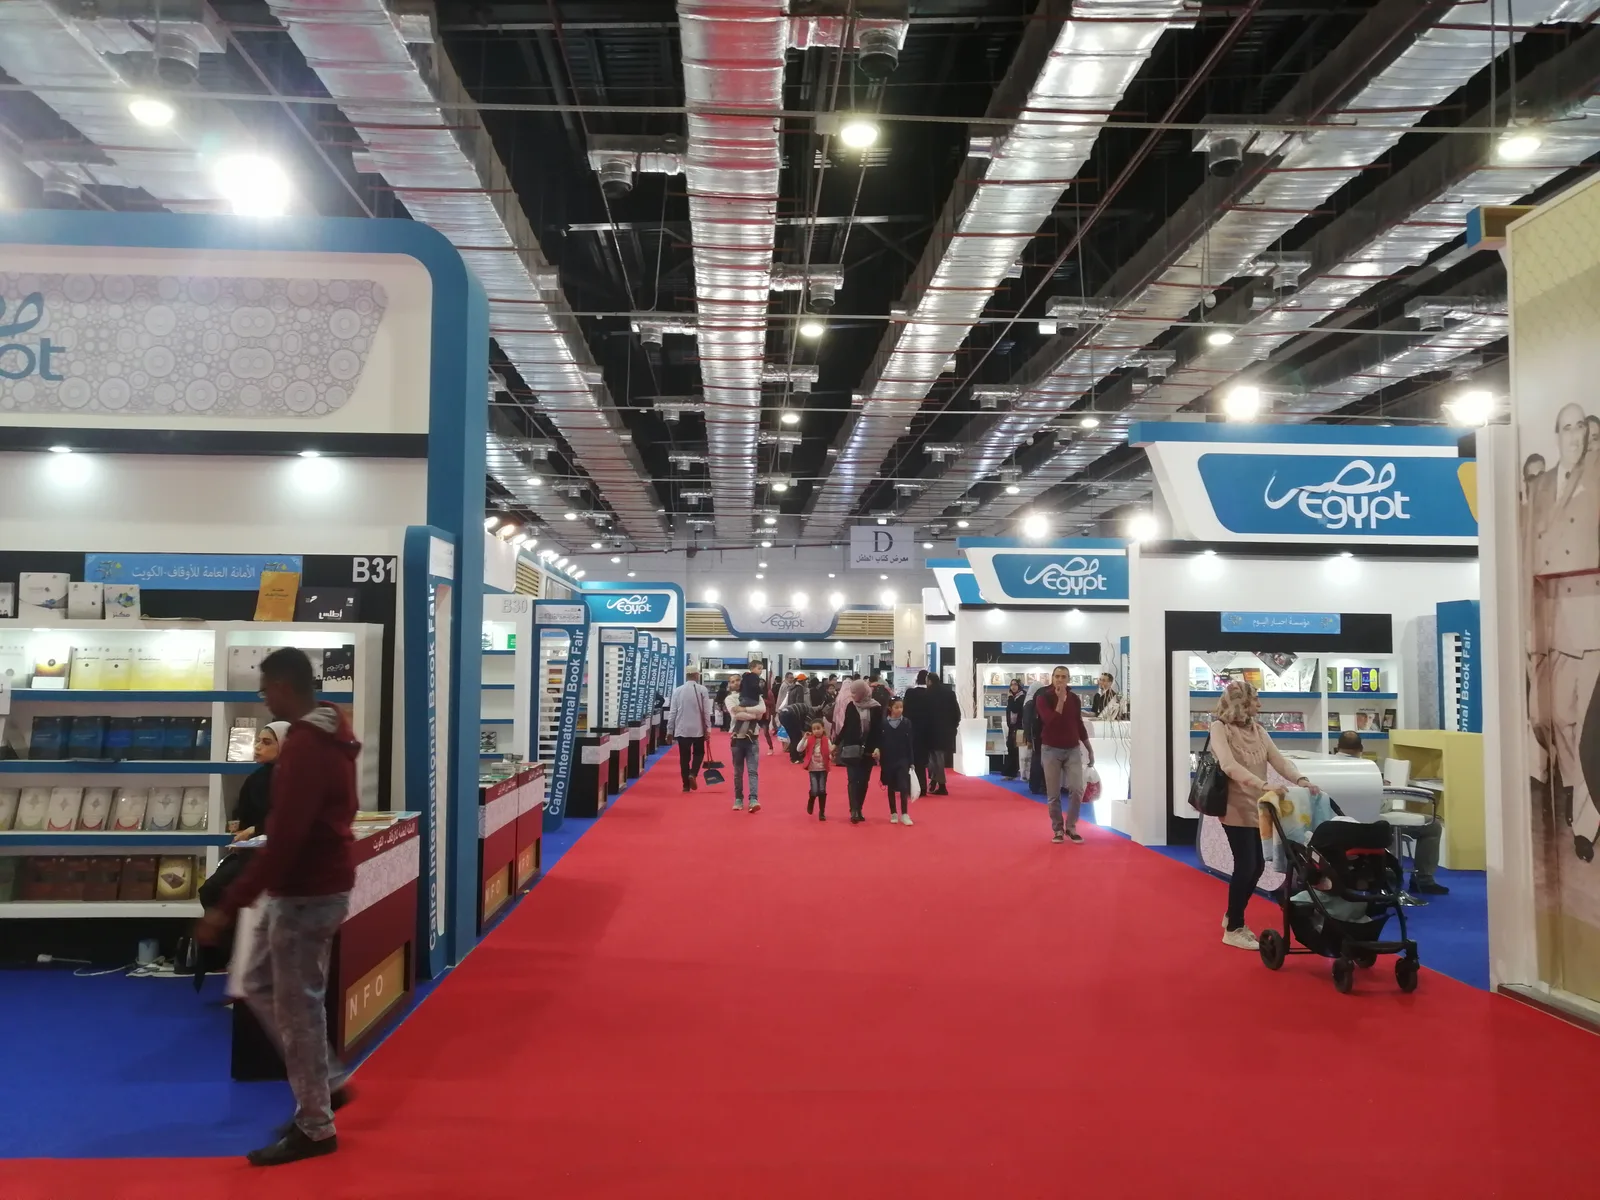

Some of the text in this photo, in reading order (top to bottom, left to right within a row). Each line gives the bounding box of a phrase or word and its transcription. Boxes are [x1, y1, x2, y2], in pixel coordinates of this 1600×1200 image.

[1298, 490, 1411, 530] Egypt
[872, 531, 893, 552] D
[875, 554, 889, 563] كتاب
[890, 554, 909, 564] معرض
[202, 567, 226, 579] العامة
[231, 567, 256, 579] الأمانة
[352, 557, 397, 583] B31
[1043, 571, 1107, 595] Egypt
[502, 598, 528, 614] B30
[616, 601, 652, 614] Egypt
[770, 616, 805, 630] Egypt
[1462, 629, 1472, 659] Fair
[626, 645, 635, 663] Fair
[642, 648, 650, 664] Fair
[652, 653, 660, 667] Fair
[623, 664, 633, 688] Book
[639, 665, 648, 686] Book
[649, 668, 658, 686] Book
[1461, 663, 1471, 701] Book
[549, 629, 585, 816] Cairo International Book Fair
[428, 584, 437, 950] Cairo International Book Fair
